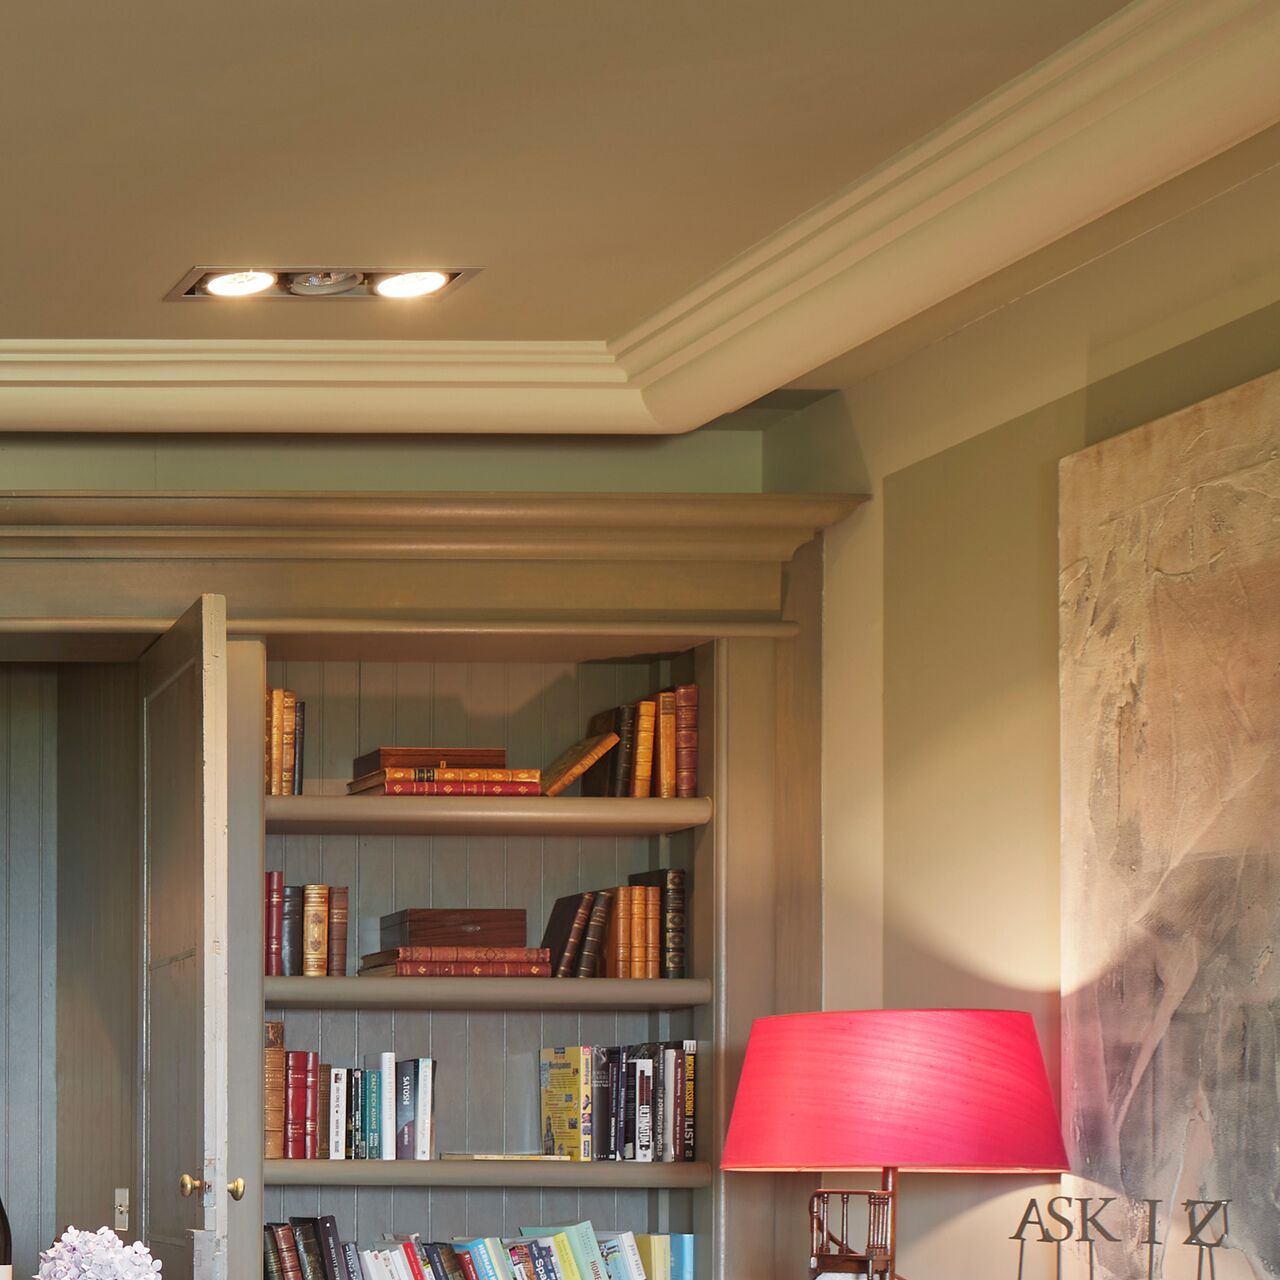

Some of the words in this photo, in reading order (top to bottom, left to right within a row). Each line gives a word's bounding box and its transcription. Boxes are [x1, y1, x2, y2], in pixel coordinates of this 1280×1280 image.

[685, 1055, 695, 1080] MICHAEL
[402, 1076, 410, 1105] SATOSHI
[639, 1105, 650, 1145] ULTIMATUM
[684, 1121, 693, 1146] LIST
[1008, 1196, 1121, 1243] ASK
[477, 1244, 495, 1276] HERMAN
